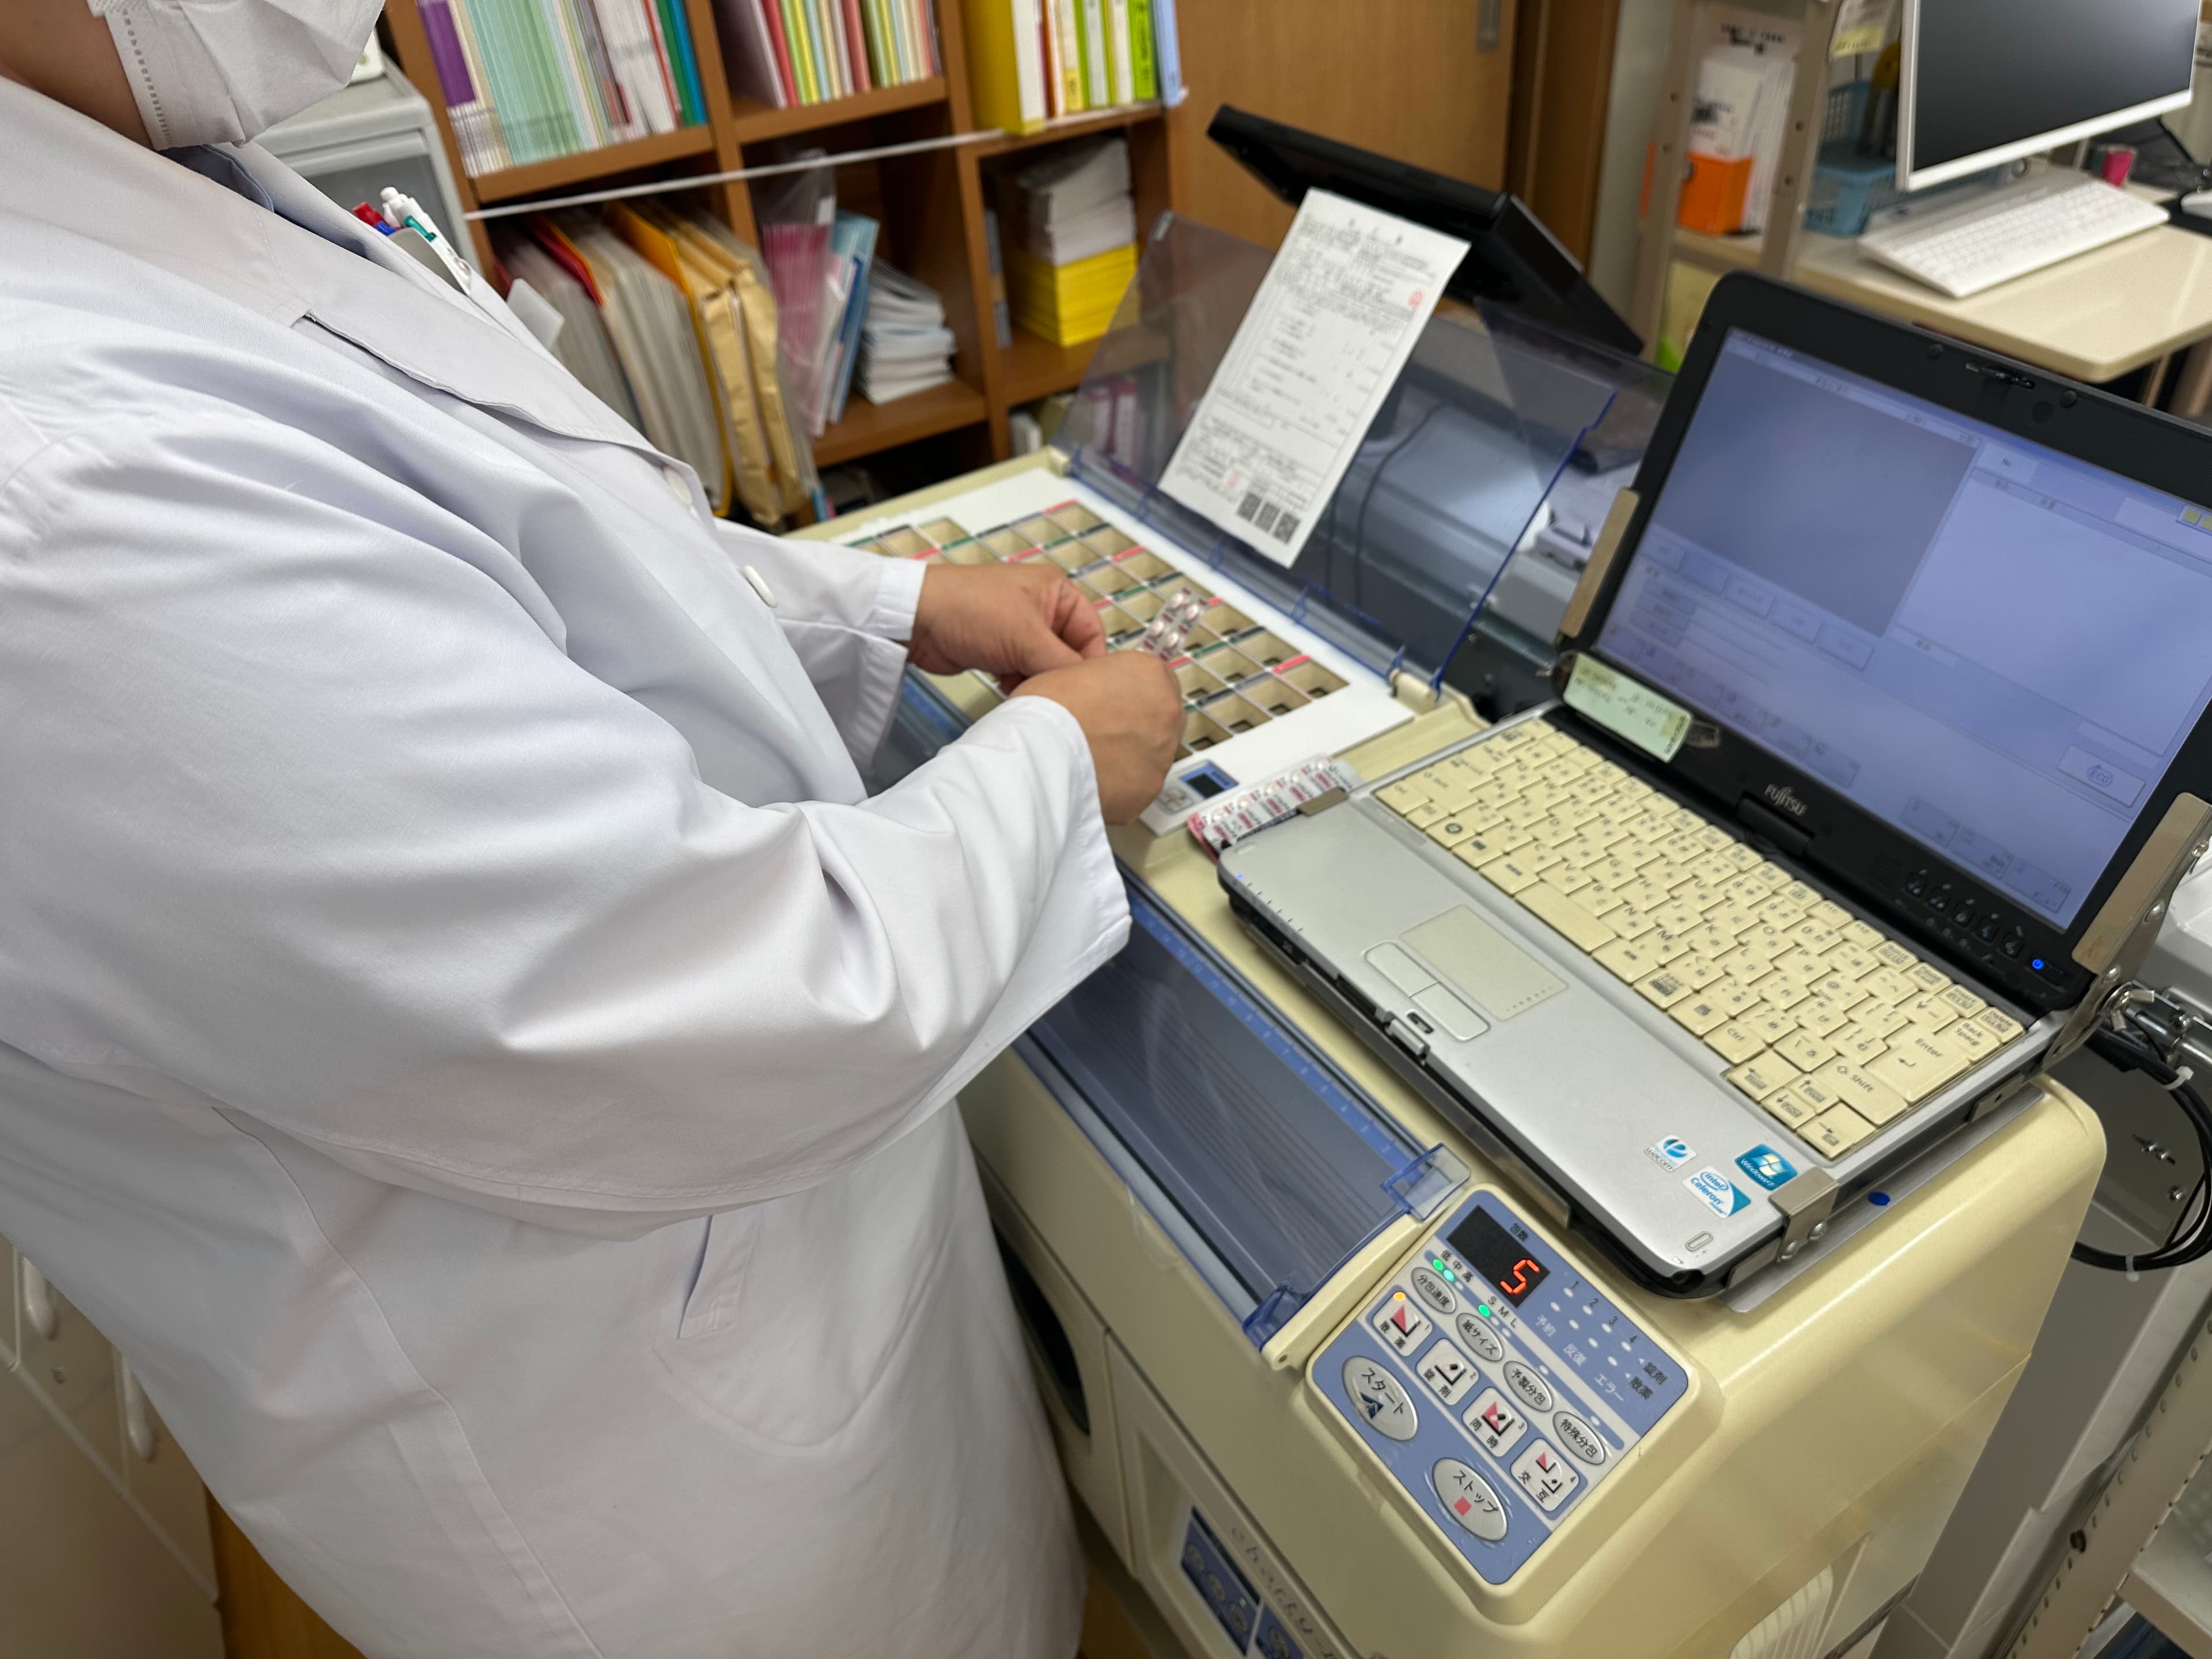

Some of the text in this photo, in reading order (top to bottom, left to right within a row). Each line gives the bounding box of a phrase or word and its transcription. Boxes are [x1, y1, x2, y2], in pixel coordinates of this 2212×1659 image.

[1764, 783, 1808, 816] FUJITSU
[1624, 907, 1637, 915] N
[1658, 930, 1672, 940] M
[1827, 980, 1840, 989] @
[1728, 1028, 1745, 1041] Ctrl
[1914, 1038, 1943, 1058] Enter
[1852, 1074, 1874, 1092] Shift
[1646, 1147, 1673, 1170] wacom
[1690, 1177, 1724, 1205] Celeron
[1453, 1260, 1462, 1270] 中
[1461, 1272, 1474, 1282] 高
[1500, 1259, 1540, 1294] 5
[1417, 1275, 1450, 1308] 分包速度
[1571, 1281, 1579, 1289] 1
[1589, 1298, 1599, 1308] 2
[1609, 1316, 1618, 1325] 3
[1488, 1297, 1517, 1328] S M L
[1536, 1315, 1556, 1336] 予約
[1461, 1320, 1498, 1354] 紙サイズ
[1361, 1367, 1404, 1414] スタート
[1511, 1368, 1546, 1405] 予製分包
[1594, 1373, 1624, 1401] エラー
[1560, 1419, 1597, 1457] 特殊分包
[1453, 1469, 1498, 1512] ストップ
